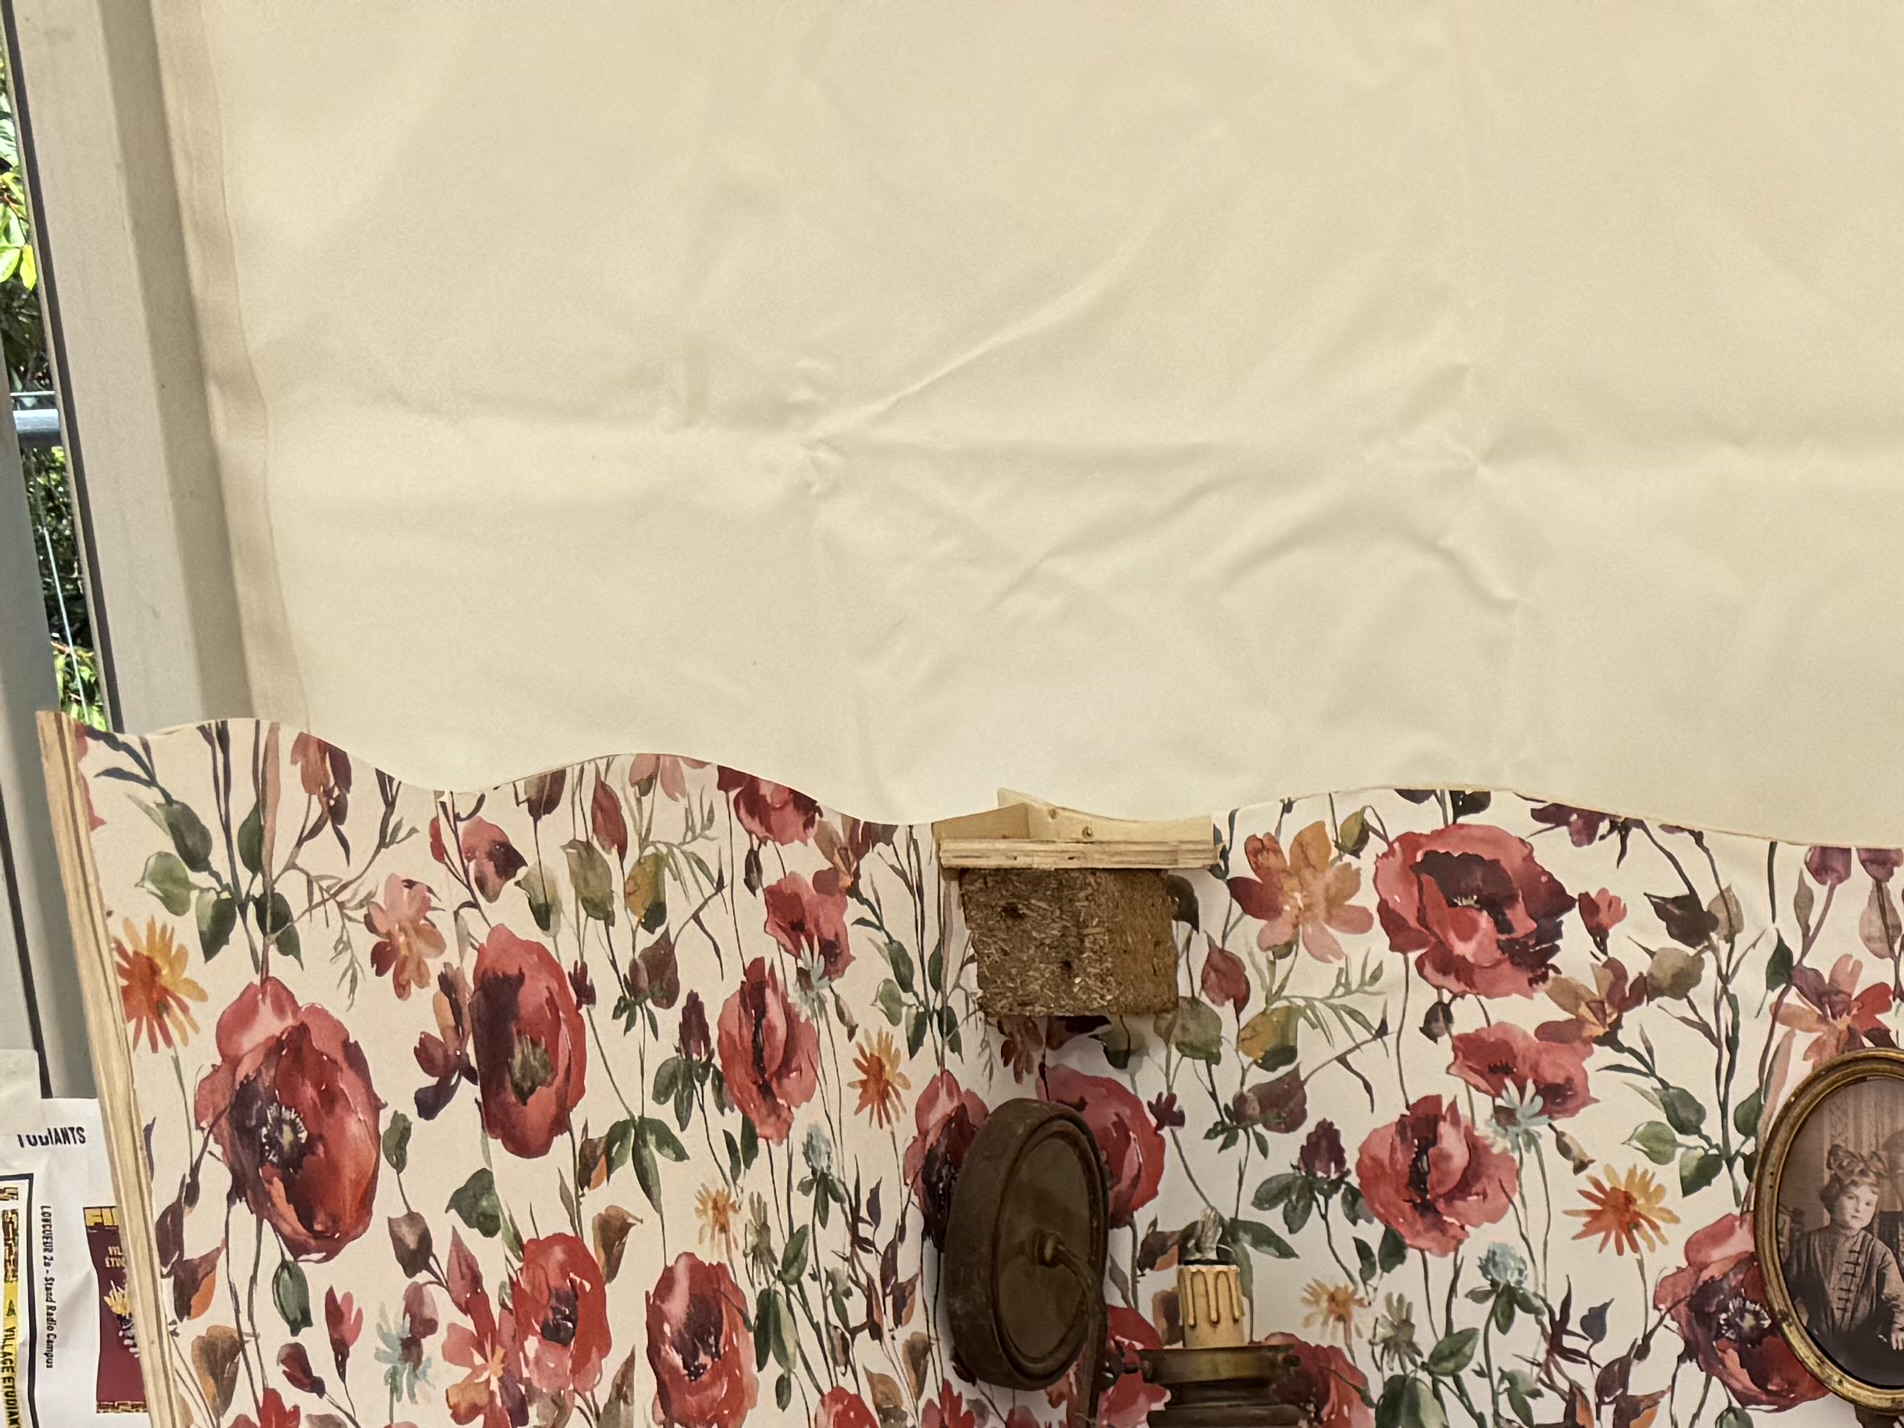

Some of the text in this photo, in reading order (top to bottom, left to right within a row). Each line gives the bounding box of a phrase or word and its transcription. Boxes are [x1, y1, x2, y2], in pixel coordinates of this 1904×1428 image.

[40, 1205, 53, 1253] LONGUEUR
[44, 1276, 56, 1303] Stand
[46, 1305, 57, 1331] Radio
[0, 1326, 16, 1373] VILLAGE
[44, 1333, 57, 1369] Campus
